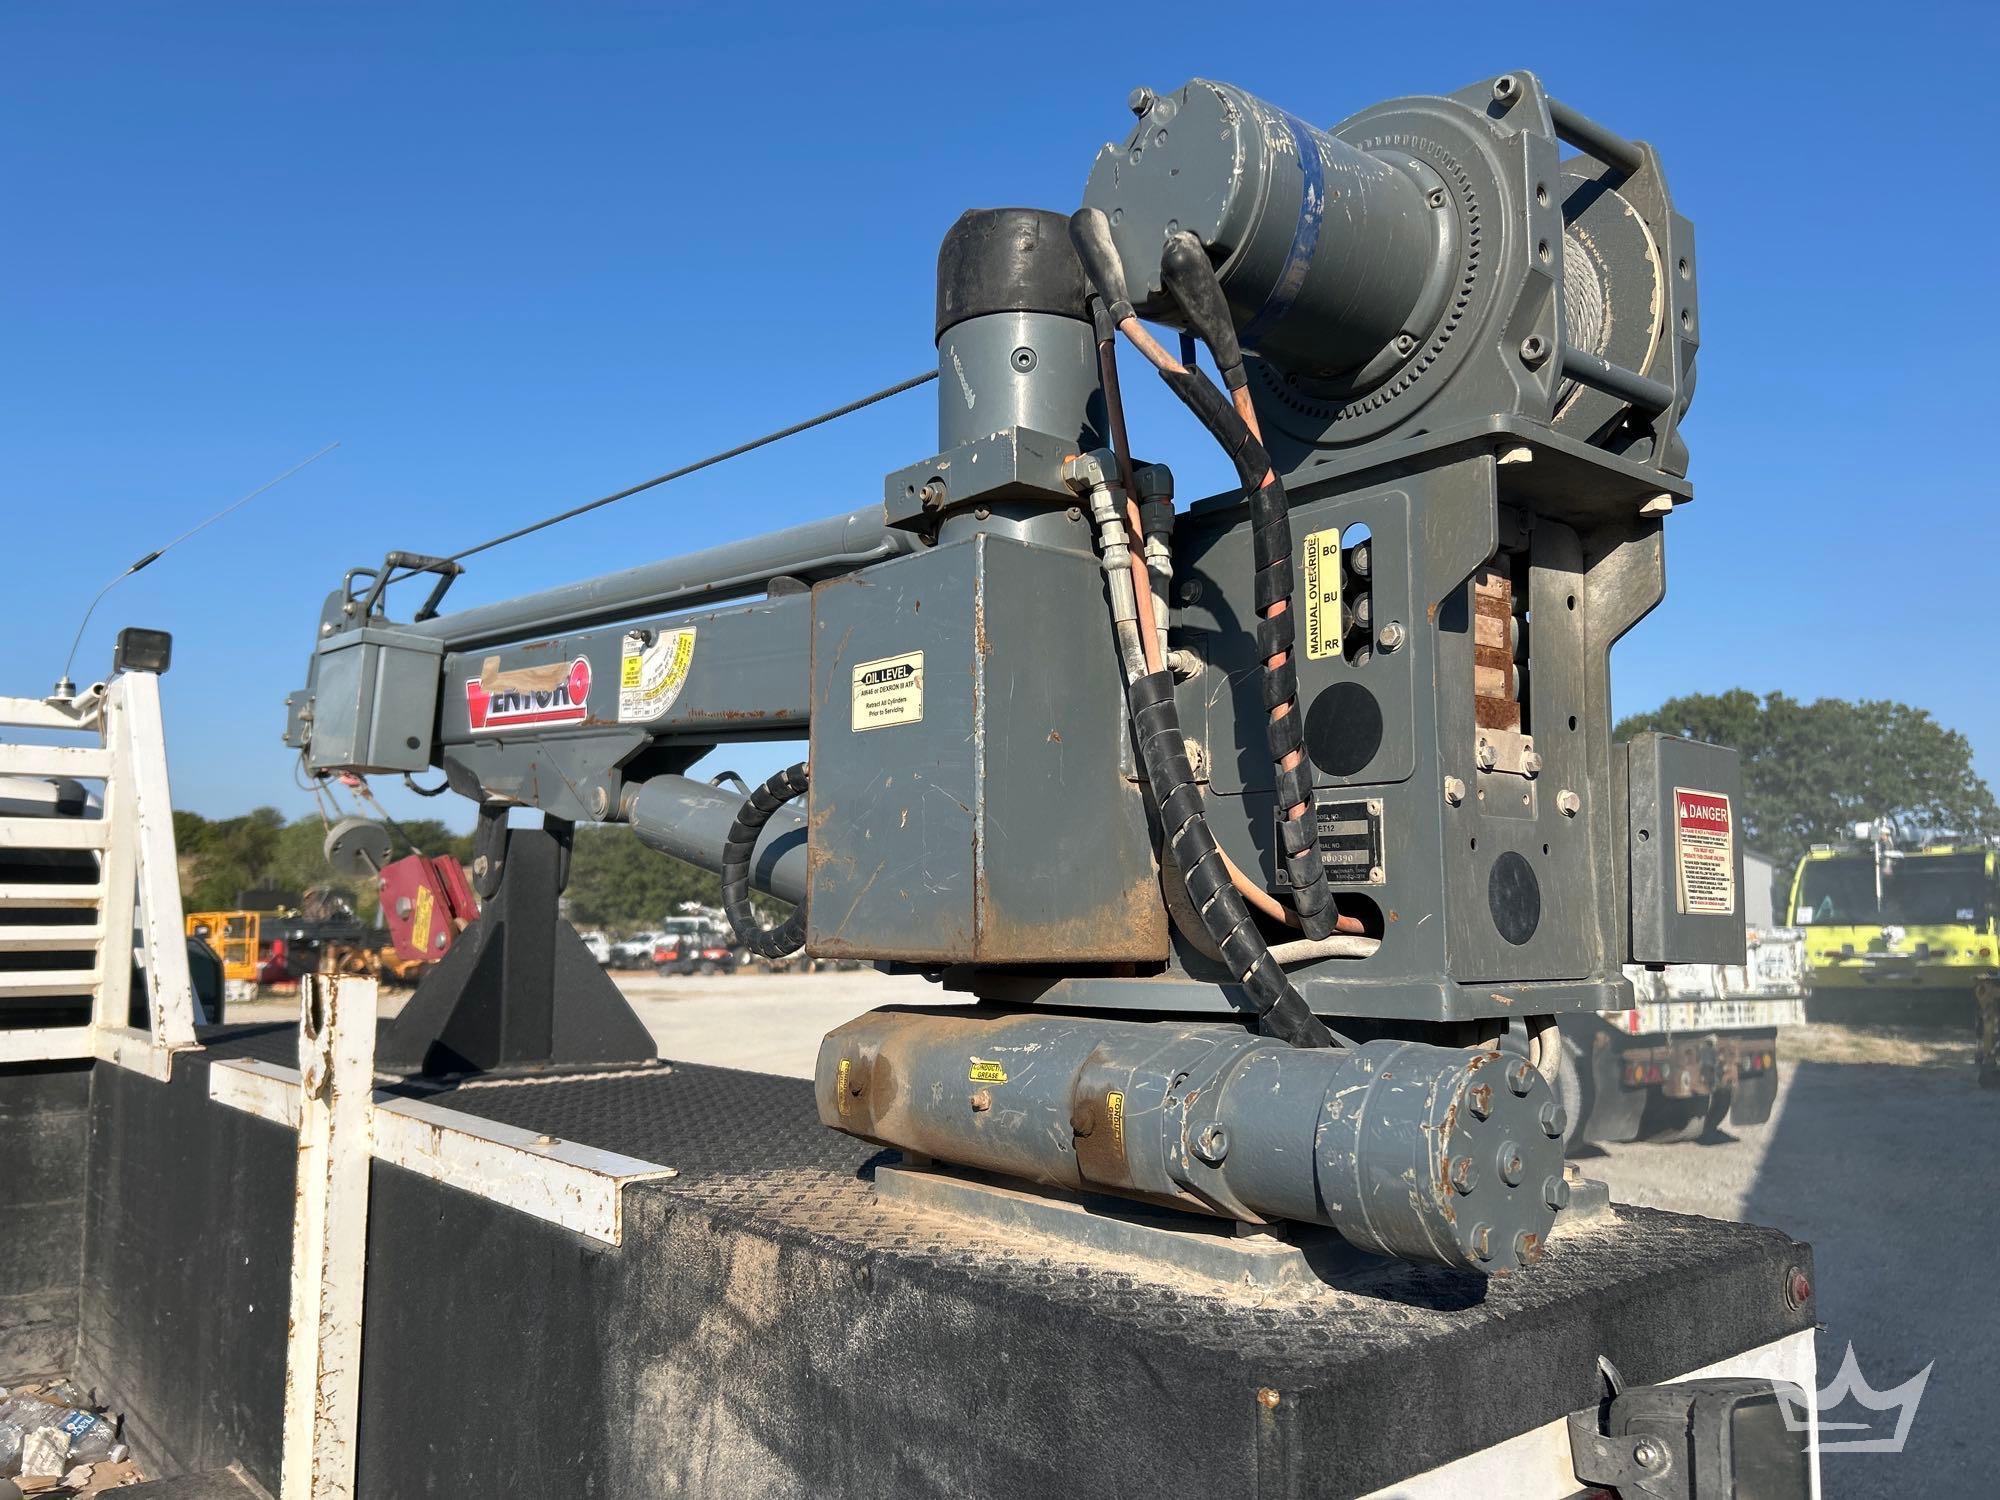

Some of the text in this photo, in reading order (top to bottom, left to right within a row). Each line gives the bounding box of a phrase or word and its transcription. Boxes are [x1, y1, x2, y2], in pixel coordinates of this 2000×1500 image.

[1323, 545, 1337, 556] BO
[1308, 537, 1318, 654] MANUAL OVERRIDE
[1323, 591, 1338, 603] BU
[1325, 639, 1340, 651] RR
[865, 666, 909, 684] OIL LEVEL
[1689, 804, 1727, 822] DANGER
